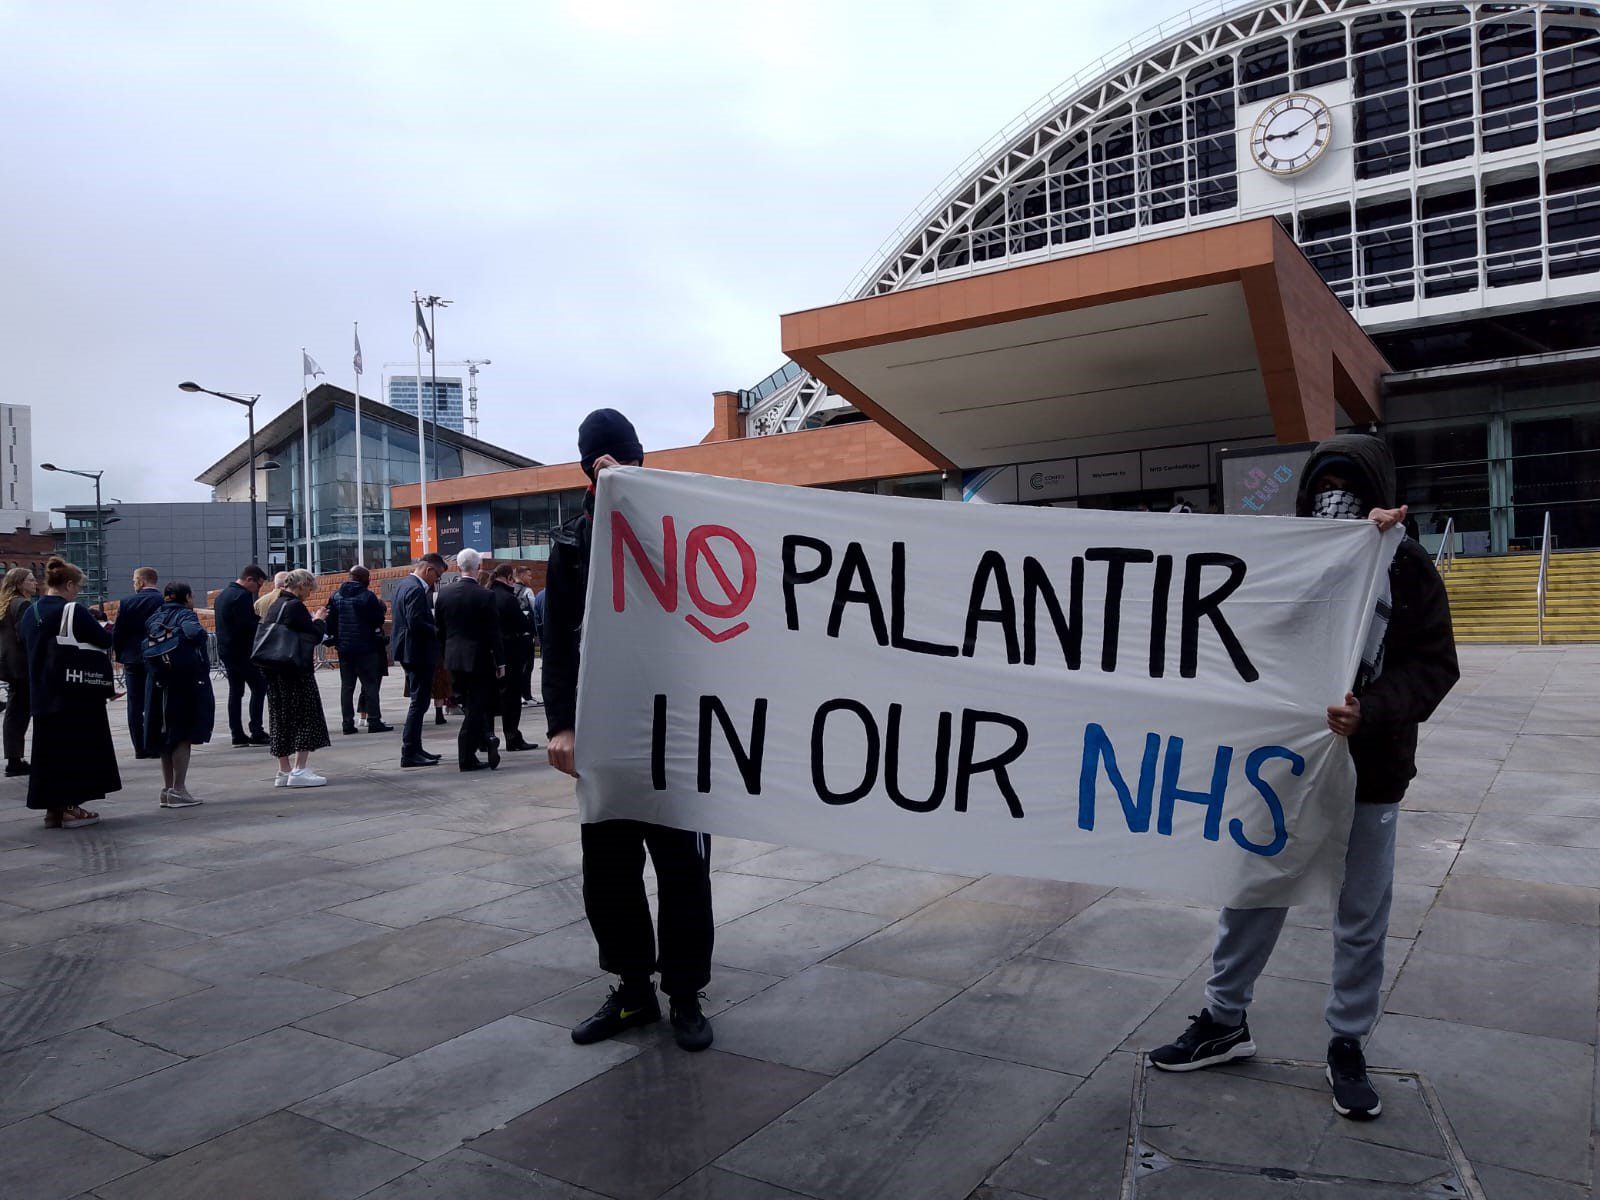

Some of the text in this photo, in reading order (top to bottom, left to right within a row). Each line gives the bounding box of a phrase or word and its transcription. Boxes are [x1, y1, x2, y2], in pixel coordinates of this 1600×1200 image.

[611, 510, 1260, 682] NO PALANTIR
[651, 694, 1306, 857] IN OUR NHS
